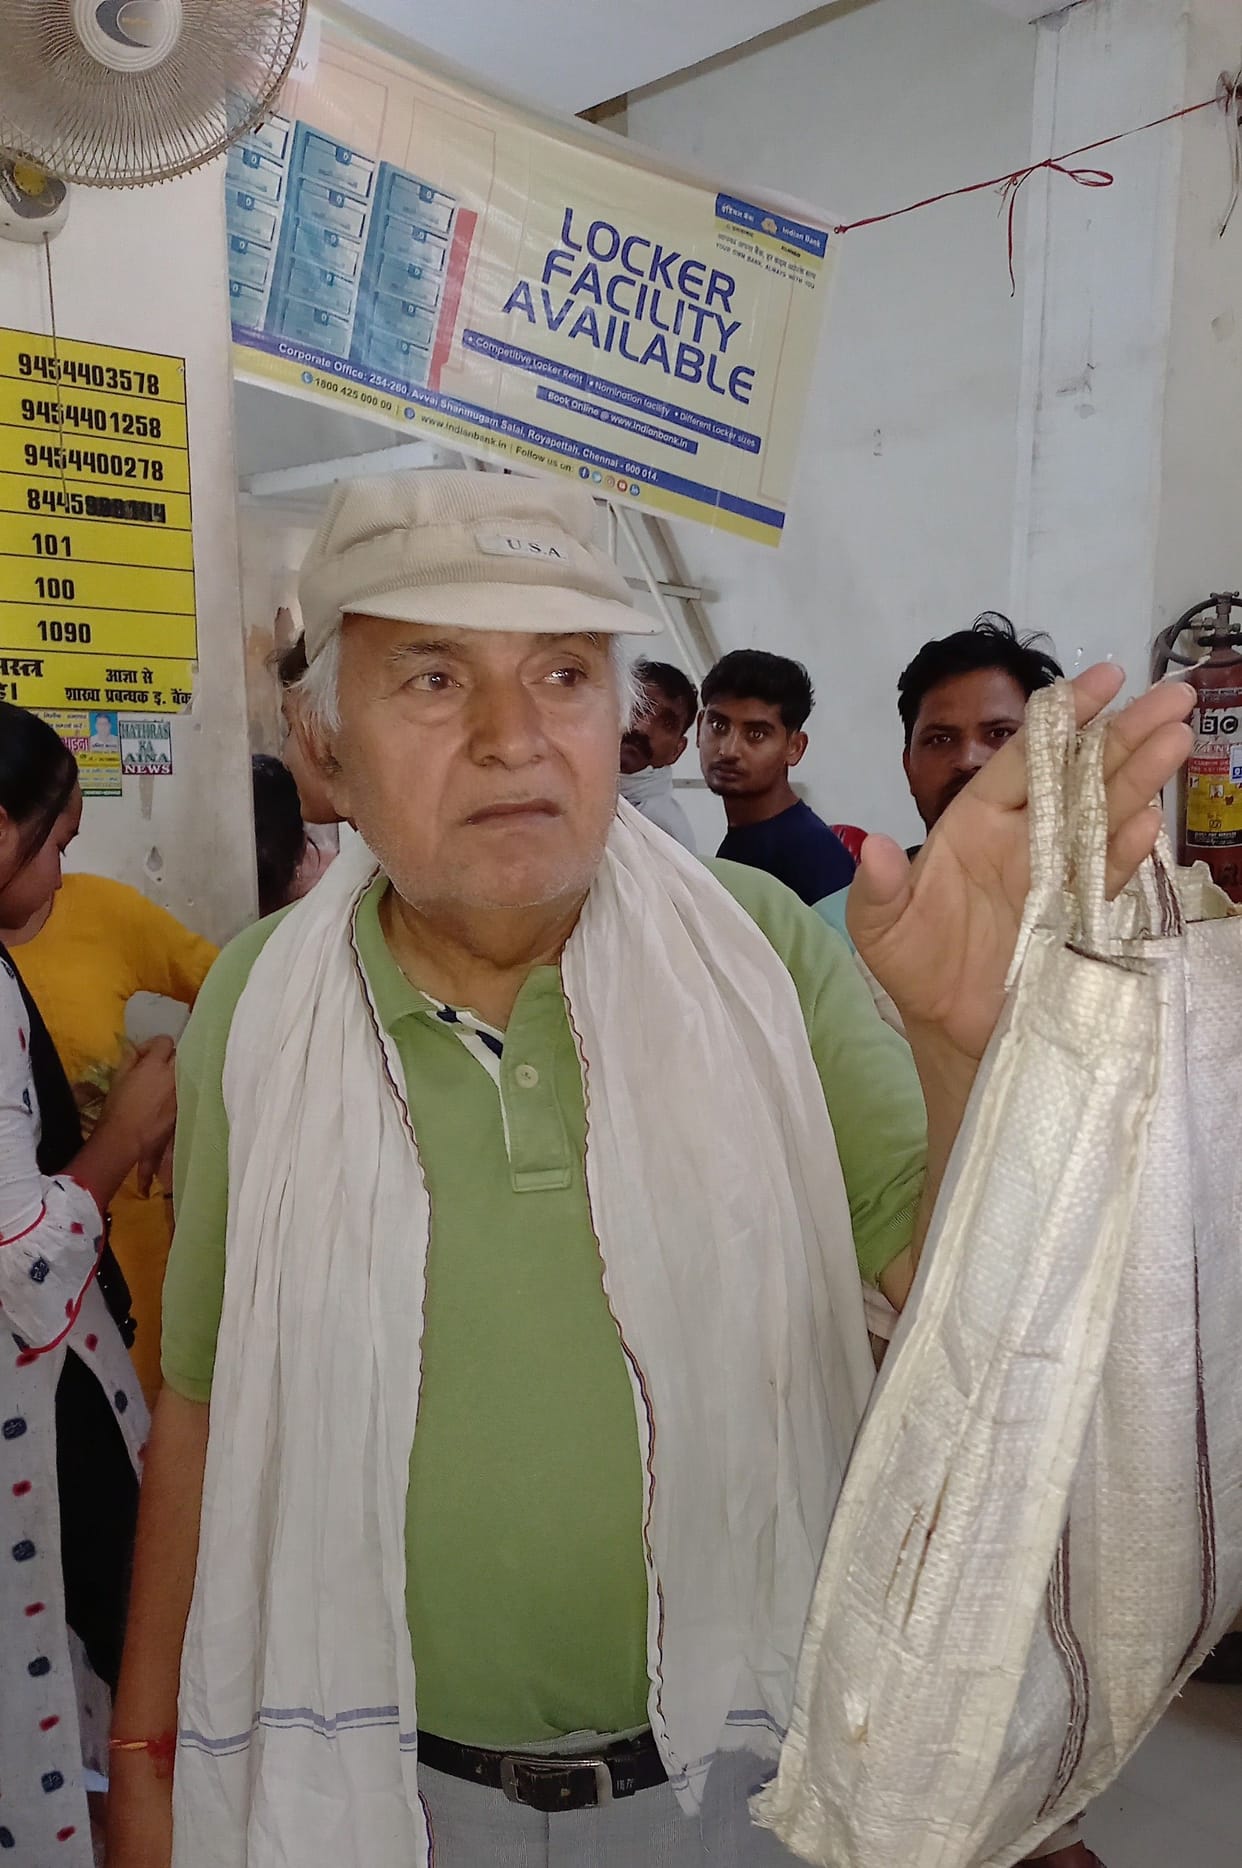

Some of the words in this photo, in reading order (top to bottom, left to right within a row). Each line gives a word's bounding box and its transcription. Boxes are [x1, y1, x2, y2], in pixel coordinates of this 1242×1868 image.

[782, 226, 804, 240] Indian
[805, 236, 820, 248] Bank
[561, 207, 735, 313] LOCKER
[541, 249, 742, 353] FACILITY
[501, 280, 755, 404] AVAILABLE
[18, 353, 160, 396] 9454403578
[475, 337, 531, 365] Competitive
[532, 358, 562, 375] Locker
[562, 369, 583, 384] Rent
[595, 382, 642, 404] Nomination
[644, 396, 671, 417] facility
[680, 412, 710, 430] Different
[712, 424, 736, 440] Locker
[737, 434, 755, 447] sizes
[548, 391, 570, 406] Book
[571, 397, 599, 416] Online
[21, 398, 162, 439] 9454401258
[278, 343, 331, 368] Corporate
[333, 361, 368, 381] Office:
[369, 373, 410, 396] 254-260,
[412, 388, 438, 405] Avvai
[440, 399, 499, 428] Shanmugam
[501, 419, 526, 437] Salai,
[527, 428, 581, 457] Royapettah,
[583, 448, 618, 469] Chennai
[625, 463, 641, 475] 600
[314, 377, 338, 393] 1800
[340, 387, 358, 399] 425
[360, 392, 378, 406] 000
[380, 400, 392, 411] 00
[420, 415, 506, 449] www.indianbank.in
[516, 446, 545, 463] Follow
[547, 458, 558, 467] us
[24, 443, 164, 482] 9454400278
[32, 533, 71, 557] 101
[35, 577, 75, 600] 100
[37, 620, 91, 644] 1090
[105, 668, 138, 683] आज्ञा
[141, 667, 154, 684] से
[64, 687, 101, 702] शाखा
[121, 723, 169, 739] HATHRAS
[124, 753, 169, 762] AINA
[124, 764, 170, 774] NEWS
